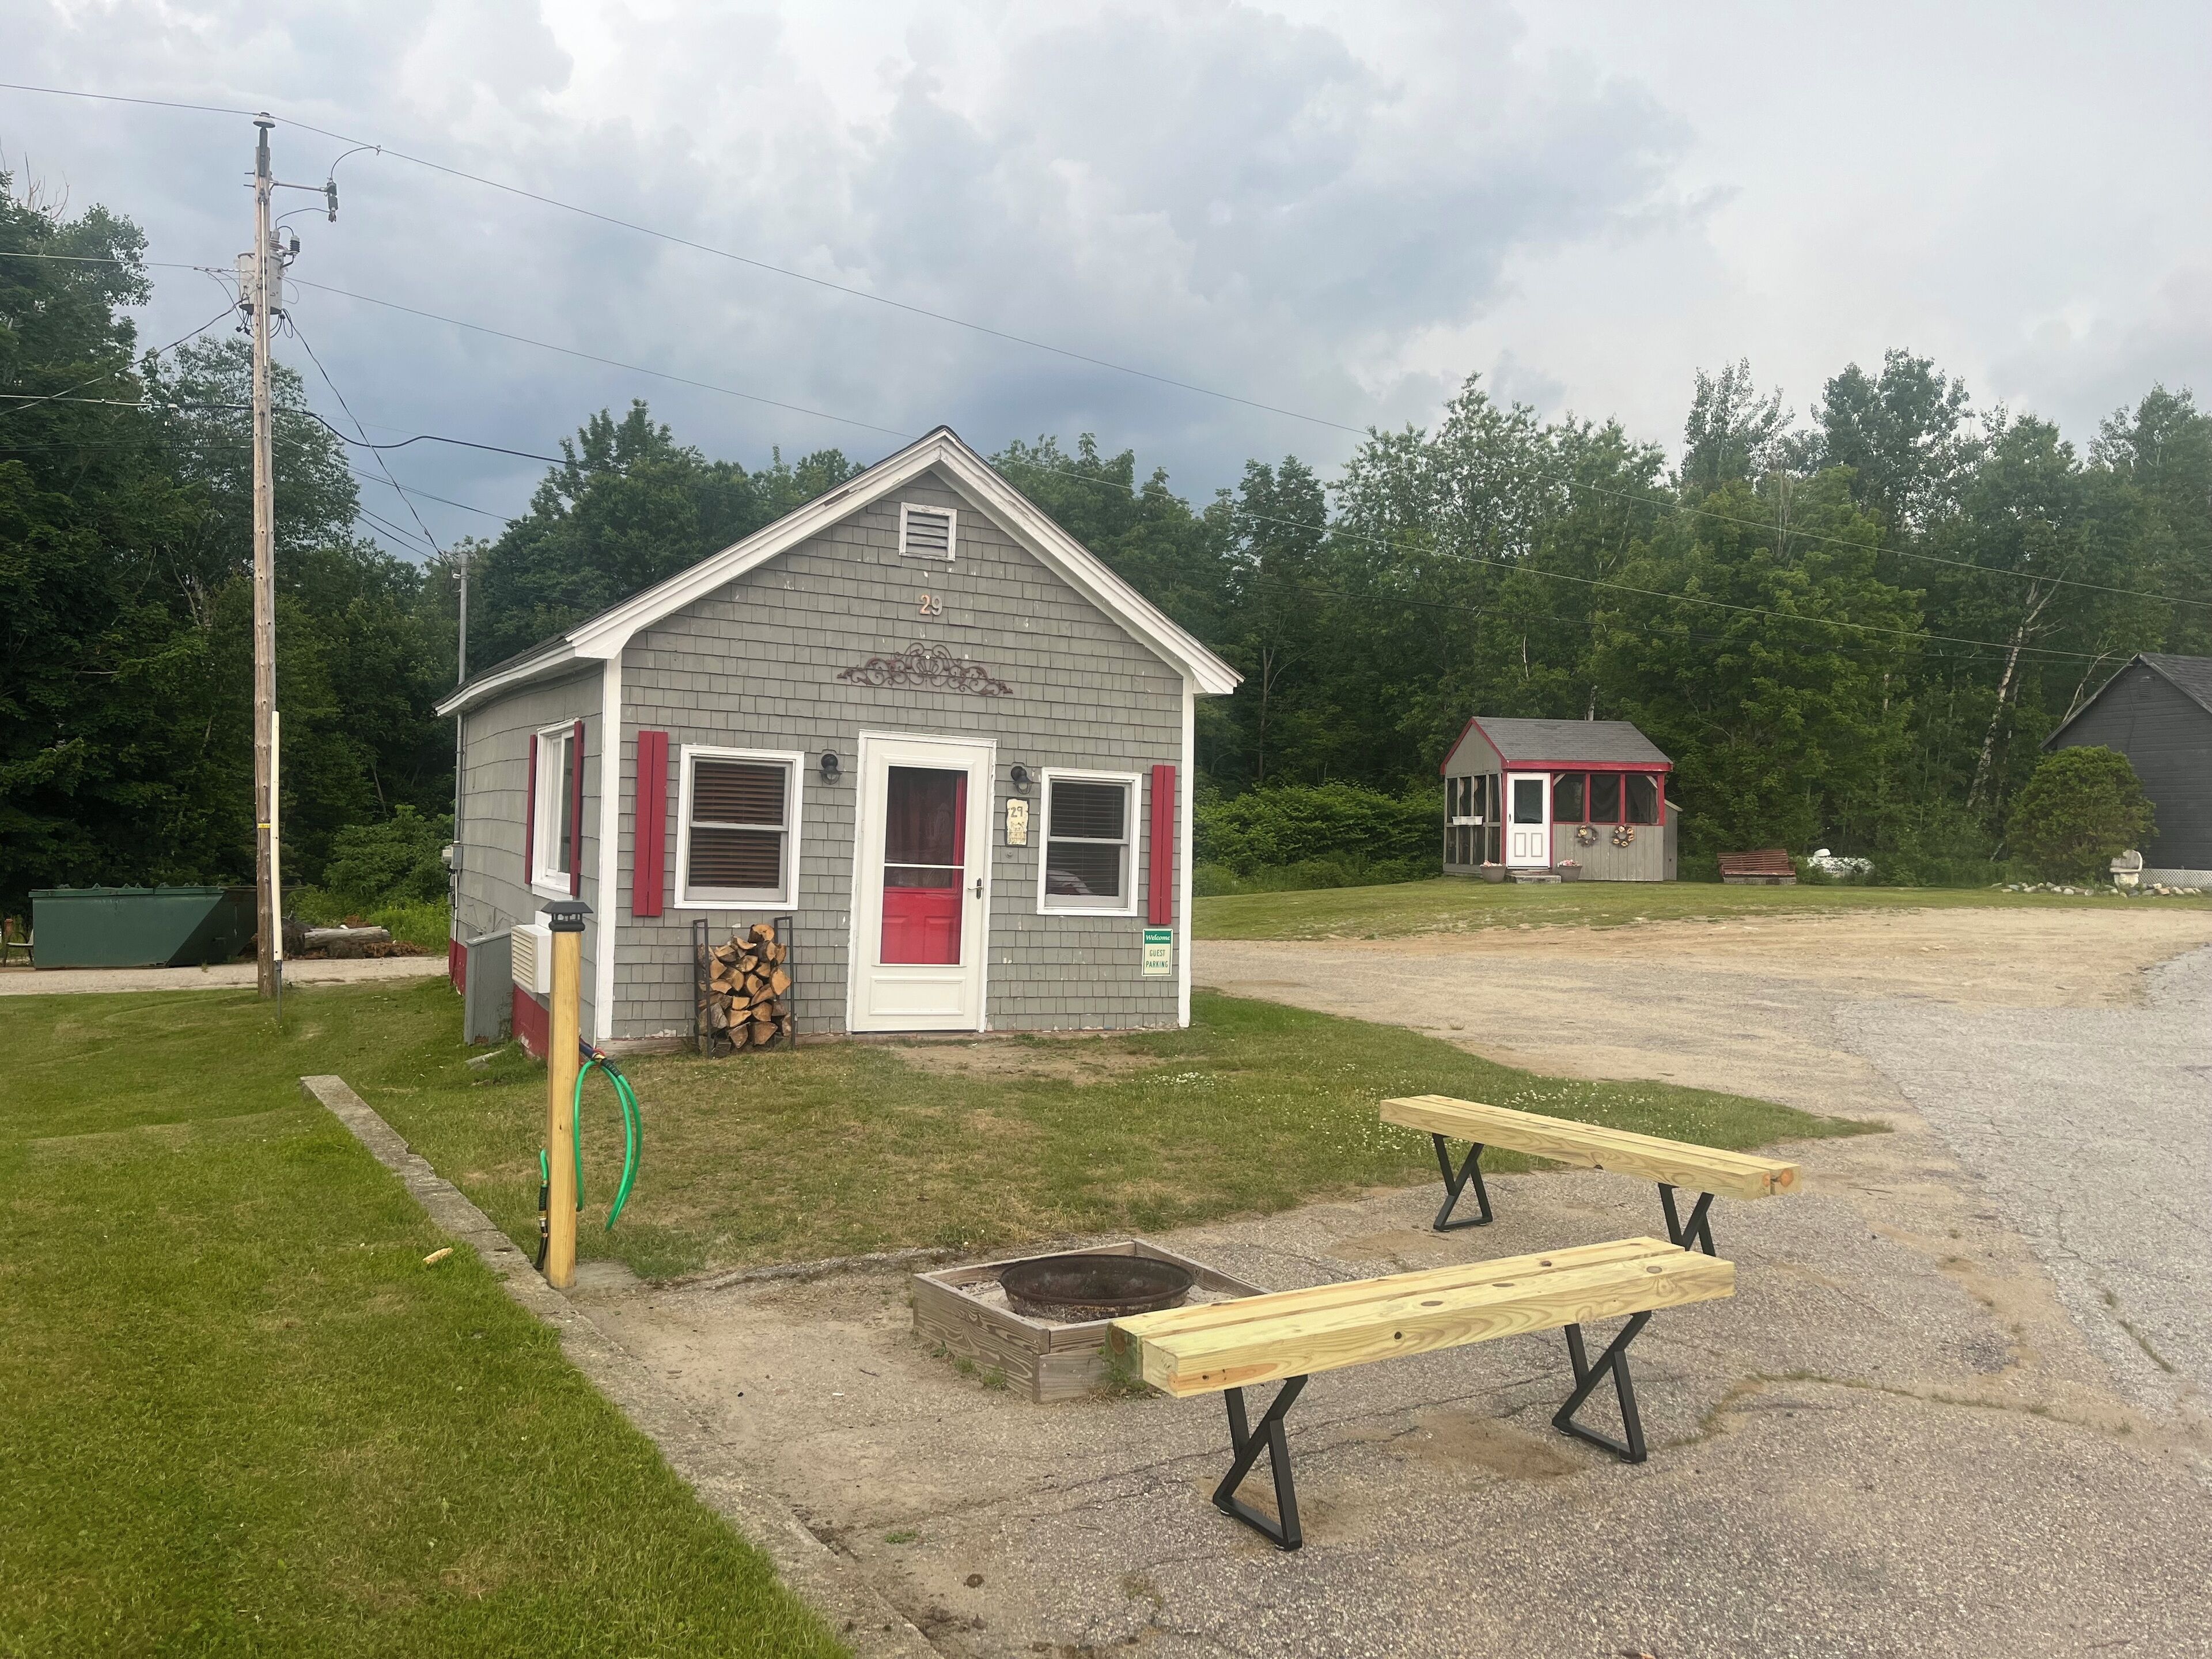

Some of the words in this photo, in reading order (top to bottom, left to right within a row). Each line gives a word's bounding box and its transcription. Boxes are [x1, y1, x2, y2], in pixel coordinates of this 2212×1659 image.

[919, 594, 942, 616] 29
[1010, 806, 1023, 818] 29
[1149, 949, 1165, 957] GUEST
